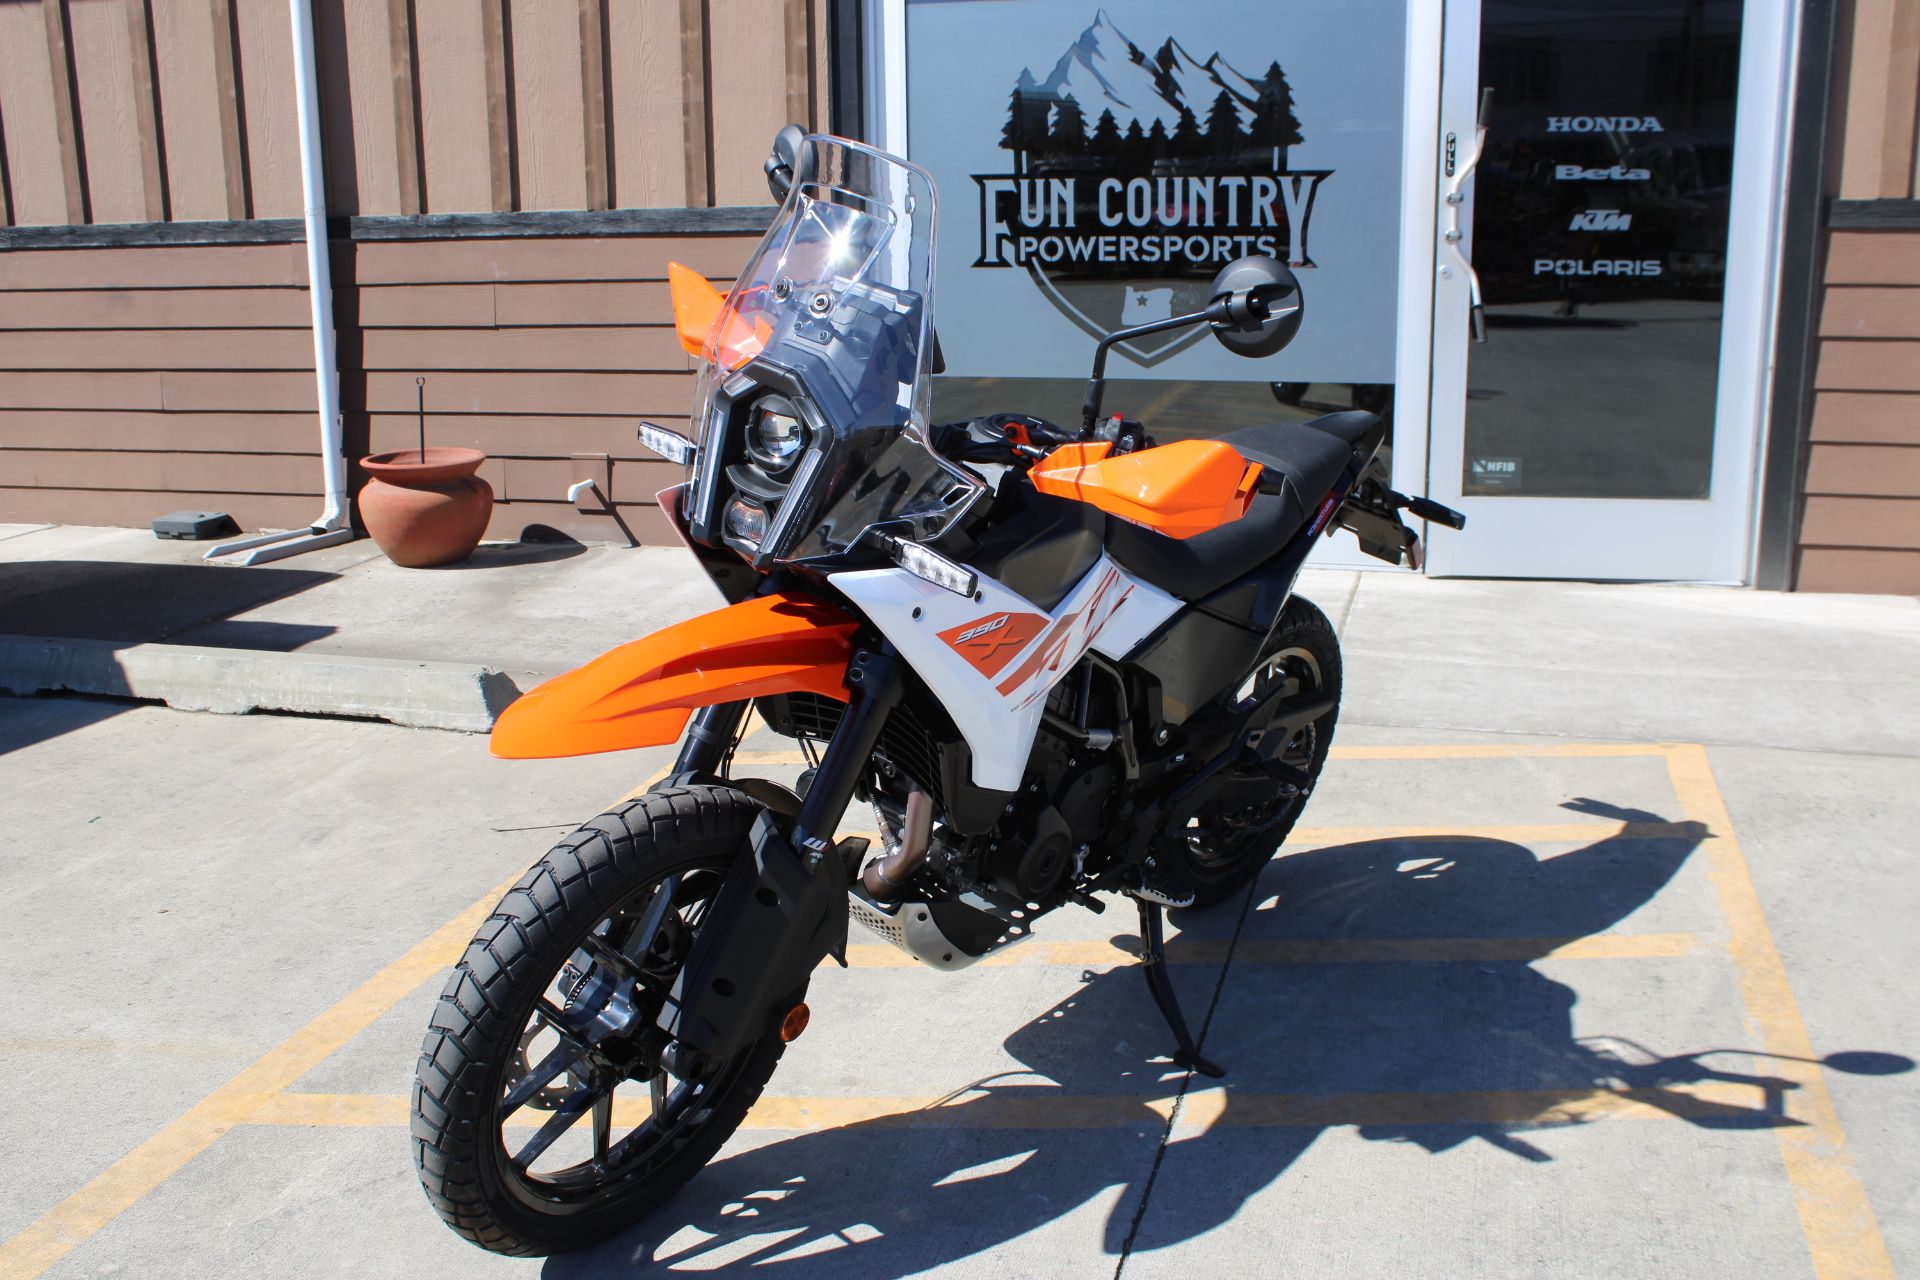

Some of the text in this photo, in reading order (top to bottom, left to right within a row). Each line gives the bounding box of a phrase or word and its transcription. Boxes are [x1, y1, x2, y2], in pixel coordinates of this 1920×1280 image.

[1546, 116, 1664, 132] HONDA
[1447, 133, 1455, 170] PULL
[1555, 164, 1650, 180] Beta
[982, 175, 1318, 263] FUN COUNTRY
[1568, 209, 1632, 231] KTM
[1020, 236, 1277, 262] POWERSPORTS
[1534, 259, 1663, 276] POLARIS
[1487, 461, 1515, 472] NFIB
[953, 613, 1010, 645] 390
